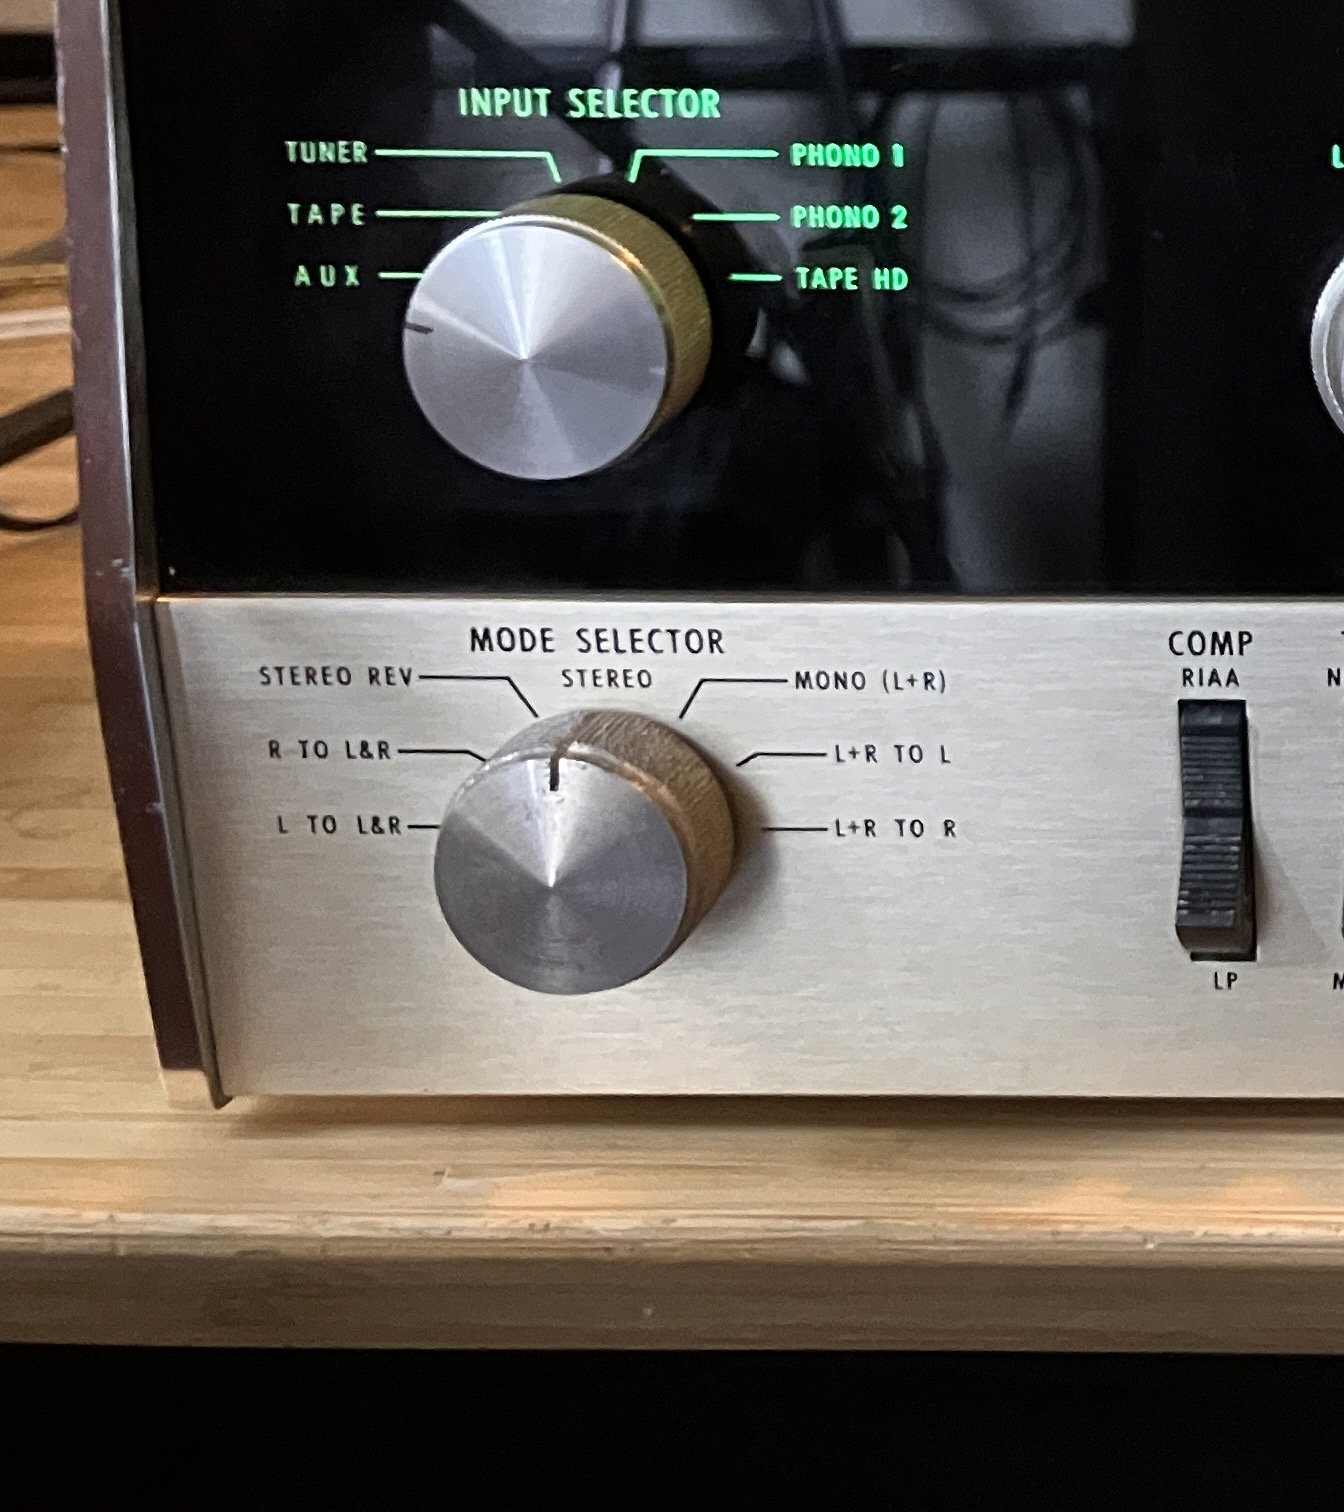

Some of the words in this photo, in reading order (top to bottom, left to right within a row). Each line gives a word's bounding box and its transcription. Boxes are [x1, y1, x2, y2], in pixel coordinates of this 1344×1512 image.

[459, 88, 550, 117] INPUT
[568, 88, 720, 118] SELECTOR
[285, 141, 367, 163] TUNER
[790, 143, 878, 168] PHONO
[891, 144, 903, 167] 1
[287, 203, 364, 225] TAPE
[790, 205, 878, 229] PHONO
[891, 205, 907, 229] 2
[294, 265, 359, 286] AUX
[796, 267, 858, 290] TAPE
[872, 268, 908, 290] HD
[470, 627, 554, 653] MODE
[576, 628, 724, 654] SELECTOR
[1168, 631, 1253, 656] COMP
[259, 666, 351, 686] STEREO
[368, 666, 411, 686] REV
[562, 669, 652, 688] STEREO
[794, 671, 866, 690] MONO
[883, 670, 946, 693] (L+R)
[1182, 668, 1239, 687] RIAA
[268, 740, 282, 758] R
[298, 740, 328, 759] TO
[344, 741, 390, 759] L&R
[834, 745, 877, 762] L+R
[894, 745, 923, 763] TO
[941, 745, 950, 763] L
[277, 816, 287, 833] L
[307, 815, 336, 834] TO
[356, 816, 401, 834] L&R
[835, 819, 877, 837] L+R
[895, 819, 924, 837] TO
[943, 819, 956, 838] R
[1214, 972, 1238, 989] LP
